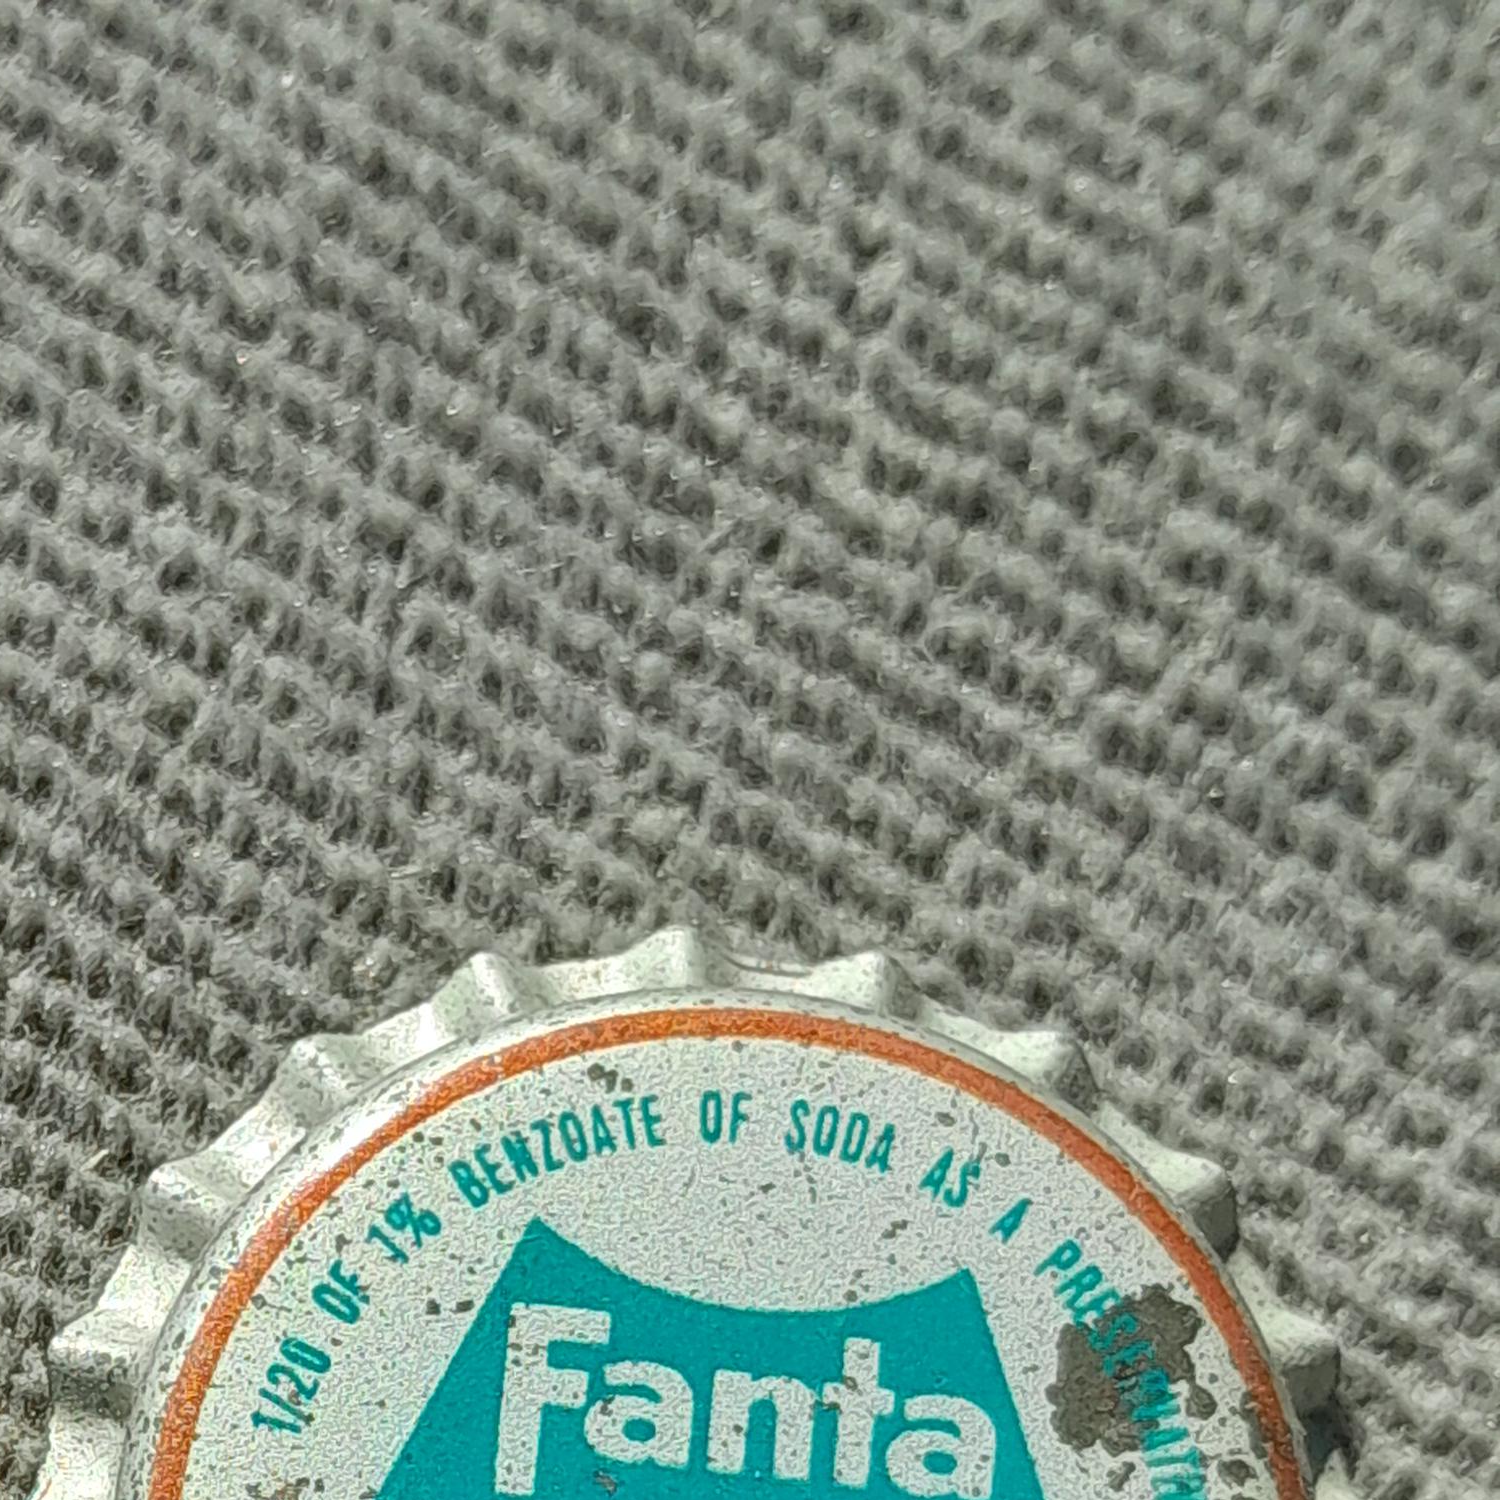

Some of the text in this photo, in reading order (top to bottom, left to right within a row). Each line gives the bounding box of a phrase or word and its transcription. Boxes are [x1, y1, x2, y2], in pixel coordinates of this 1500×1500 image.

[250, 1336, 332, 1436] 1/20
[311, 1260, 369, 1326] OF
[366, 1192, 442, 1264] 1%
[448, 1094, 666, 1209] BENZOATE
[699, 1090, 752, 1144] OF
[784, 1099, 897, 1174] SODA
[918, 1148, 981, 1208] AS
[988, 1197, 1033, 1244] A
